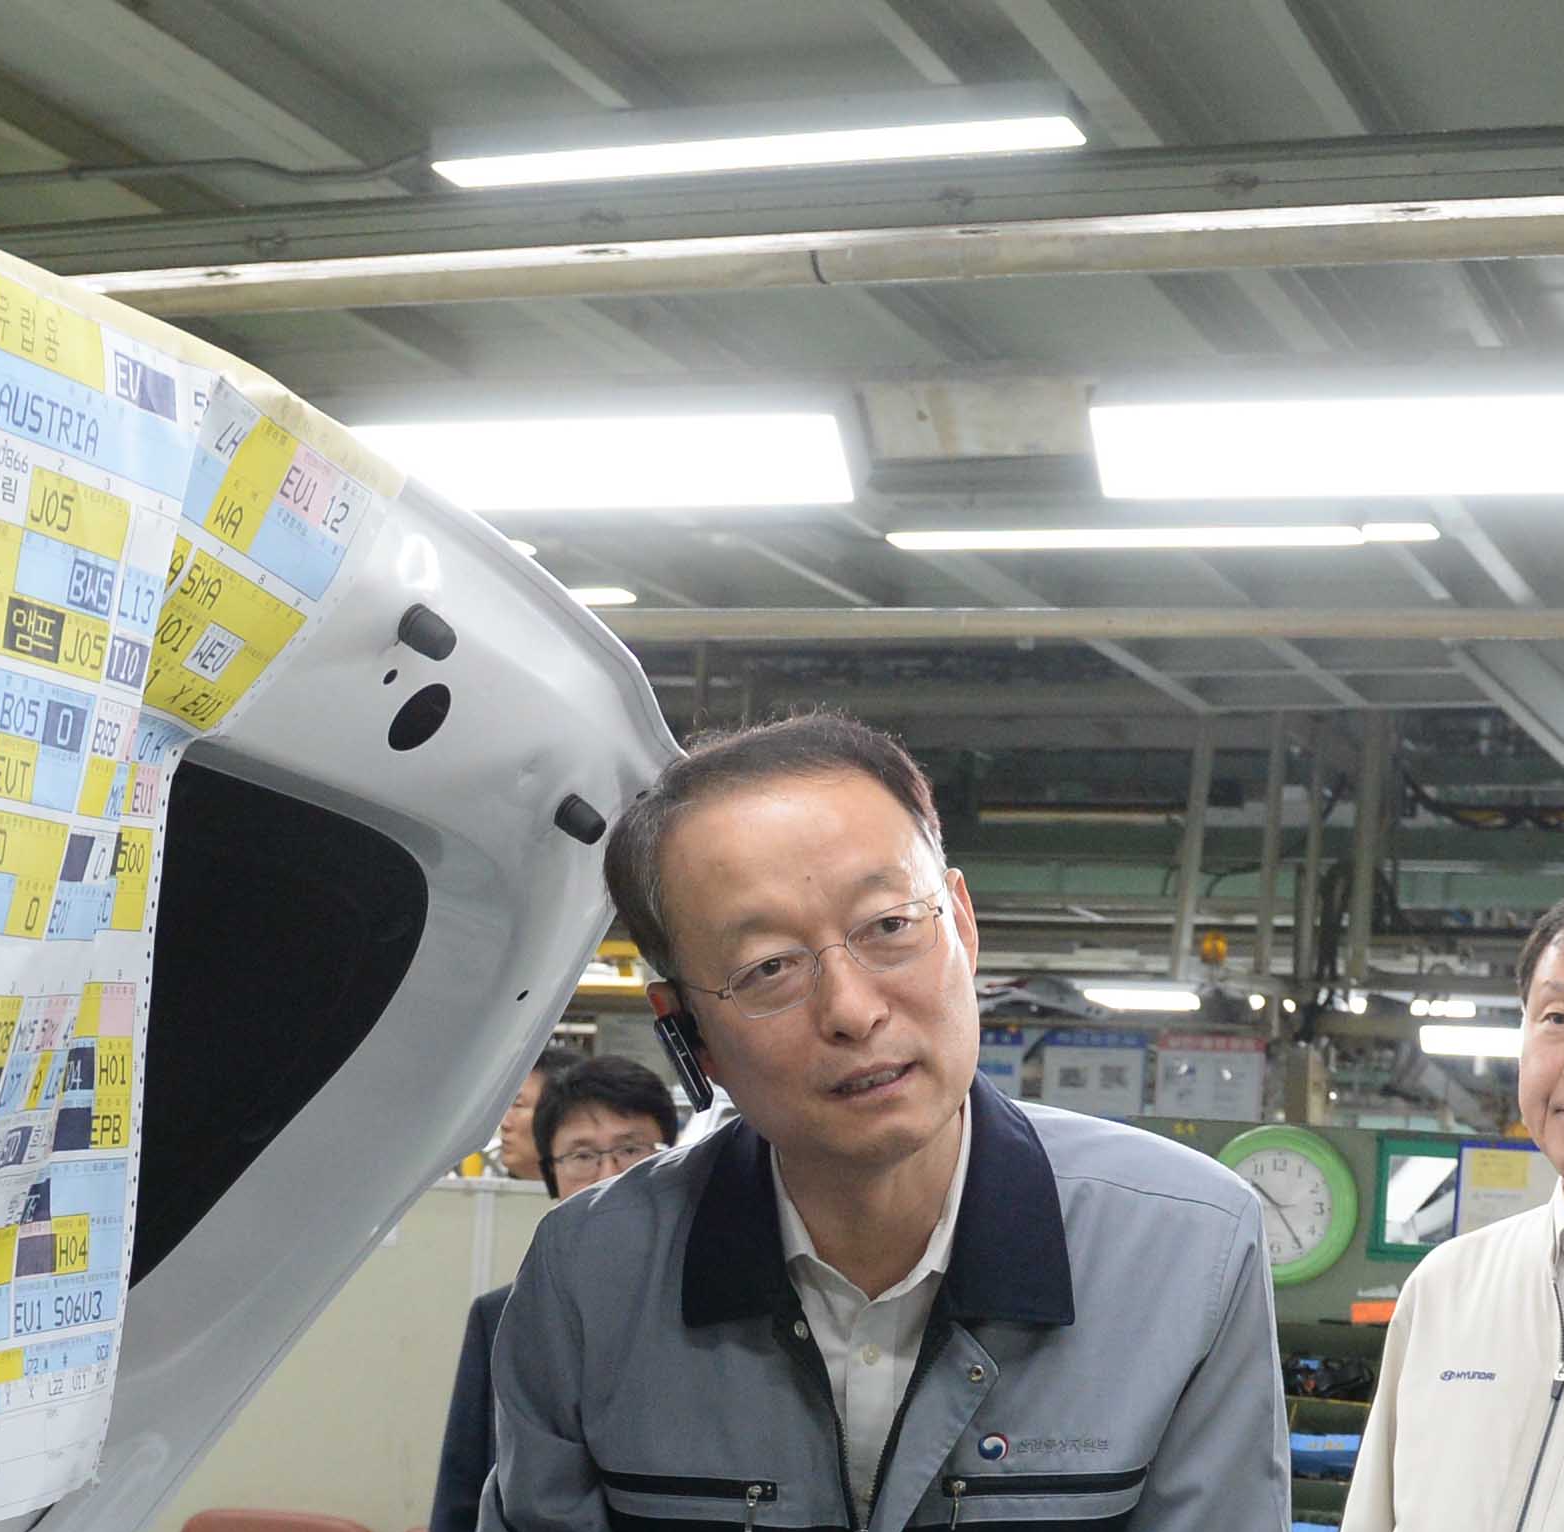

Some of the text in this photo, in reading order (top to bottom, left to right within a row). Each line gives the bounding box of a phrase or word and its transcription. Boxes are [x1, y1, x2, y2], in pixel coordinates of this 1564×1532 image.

[70, 560, 115, 612] BWS
[99, 1055, 127, 1087] H01
[58, 1236, 88, 1268] H04
